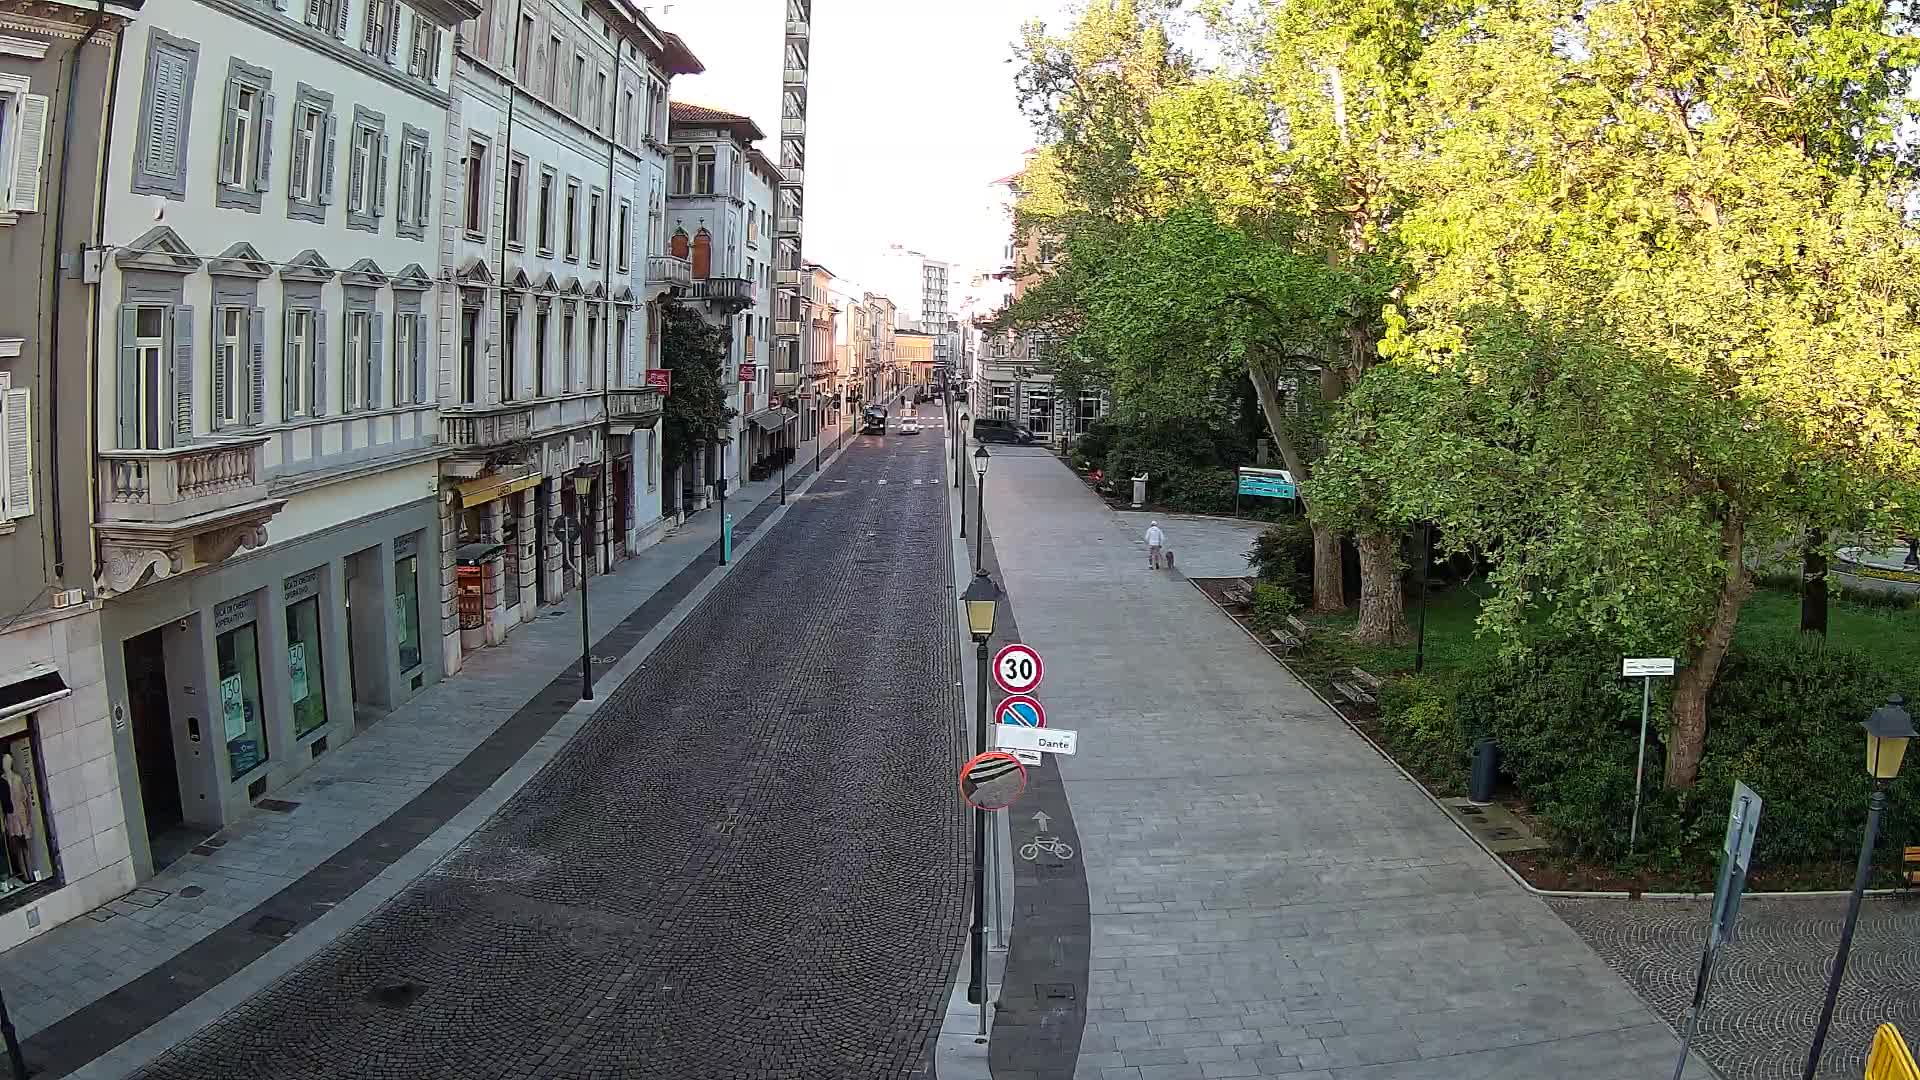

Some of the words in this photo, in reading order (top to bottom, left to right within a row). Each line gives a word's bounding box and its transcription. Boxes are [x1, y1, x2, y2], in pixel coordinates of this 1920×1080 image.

[1005, 658, 1033, 680] 30
[221, 677, 240, 700] 130
[1038, 738, 1070, 749] Dante
